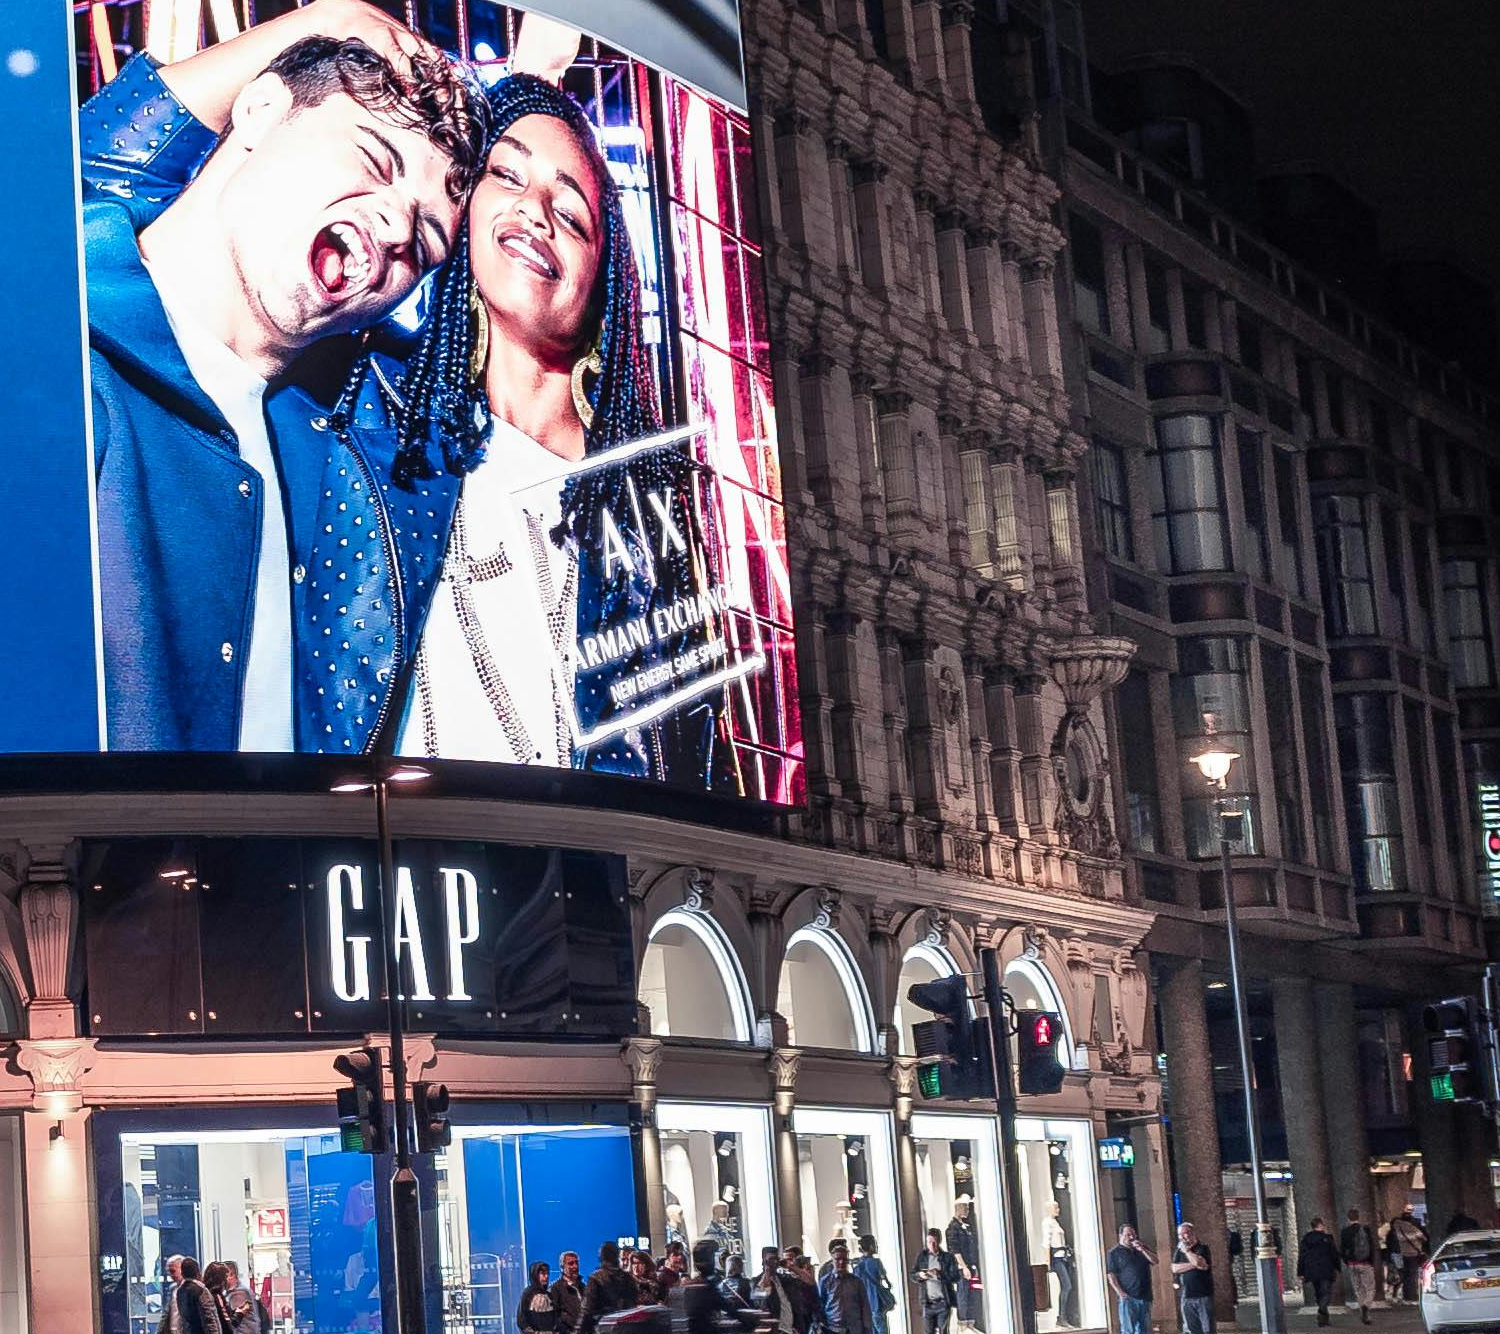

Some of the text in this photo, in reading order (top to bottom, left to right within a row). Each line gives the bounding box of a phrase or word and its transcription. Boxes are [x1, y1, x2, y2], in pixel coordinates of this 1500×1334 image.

[575, 617, 651, 672] ARMANI
[326, 862, 481, 1003] GAP
[1099, 1144, 1121, 1161] GAP
[261, 1208, 287, 1223] SA
[259, 1223, 286, 1238] LE
